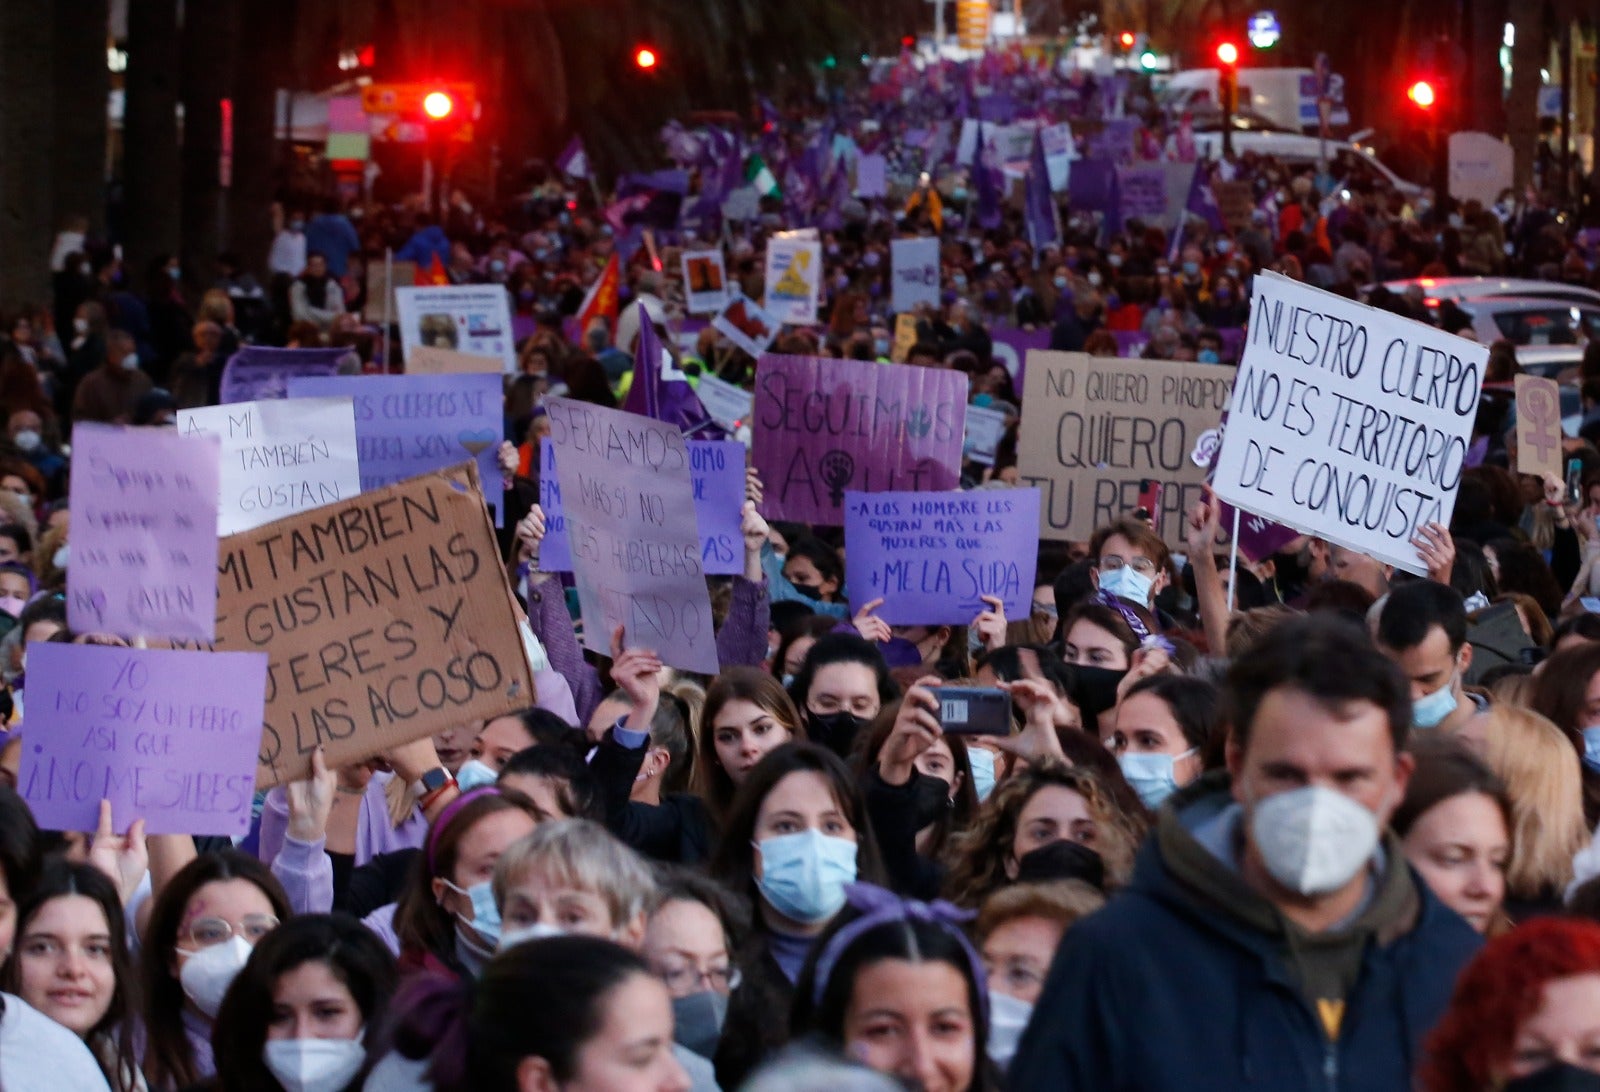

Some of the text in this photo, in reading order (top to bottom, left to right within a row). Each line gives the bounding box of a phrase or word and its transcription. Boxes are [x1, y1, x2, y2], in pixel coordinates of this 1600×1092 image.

[1253, 294, 1478, 416] NUESTRO CUERPO
[761, 371, 955, 443] SEGUIMS
[1046, 368, 1075, 399] NO
[1085, 371, 1149, 405] QUIERO
[228, 411, 253, 439] MI
[1056, 411, 1187, 471] QUIERO
[1239, 365, 1466, 492] NO ES TERRITORIO
[688, 444, 726, 473] OMO
[239, 480, 341, 513] GUSTAN
[639, 492, 666, 527] NO
[874, 501, 899, 516] LOS
[912, 501, 981, 518] HOMBRE
[987, 501, 1013, 514] LES
[1240, 438, 1442, 544] DE CONQUISTA
[256, 481, 440, 581] TAMBIEN
[869, 519, 922, 534] GUSTAN
[974, 520, 1004, 532] LAS
[881, 535, 948, 551] MUJERES
[702, 533, 734, 564] AS
[245, 560, 401, 646] GUSTAN
[403, 532, 480, 593] LAS
[960, 558, 1020, 600] SUDA
[265, 598, 464, 704] JERES Y
[112, 657, 148, 690] YO
[56, 690, 242, 731] NO SOY UN PERRO
[291, 698, 356, 757] LAS
[134, 731, 174, 755] QUE
[103, 764, 151, 808] ME
